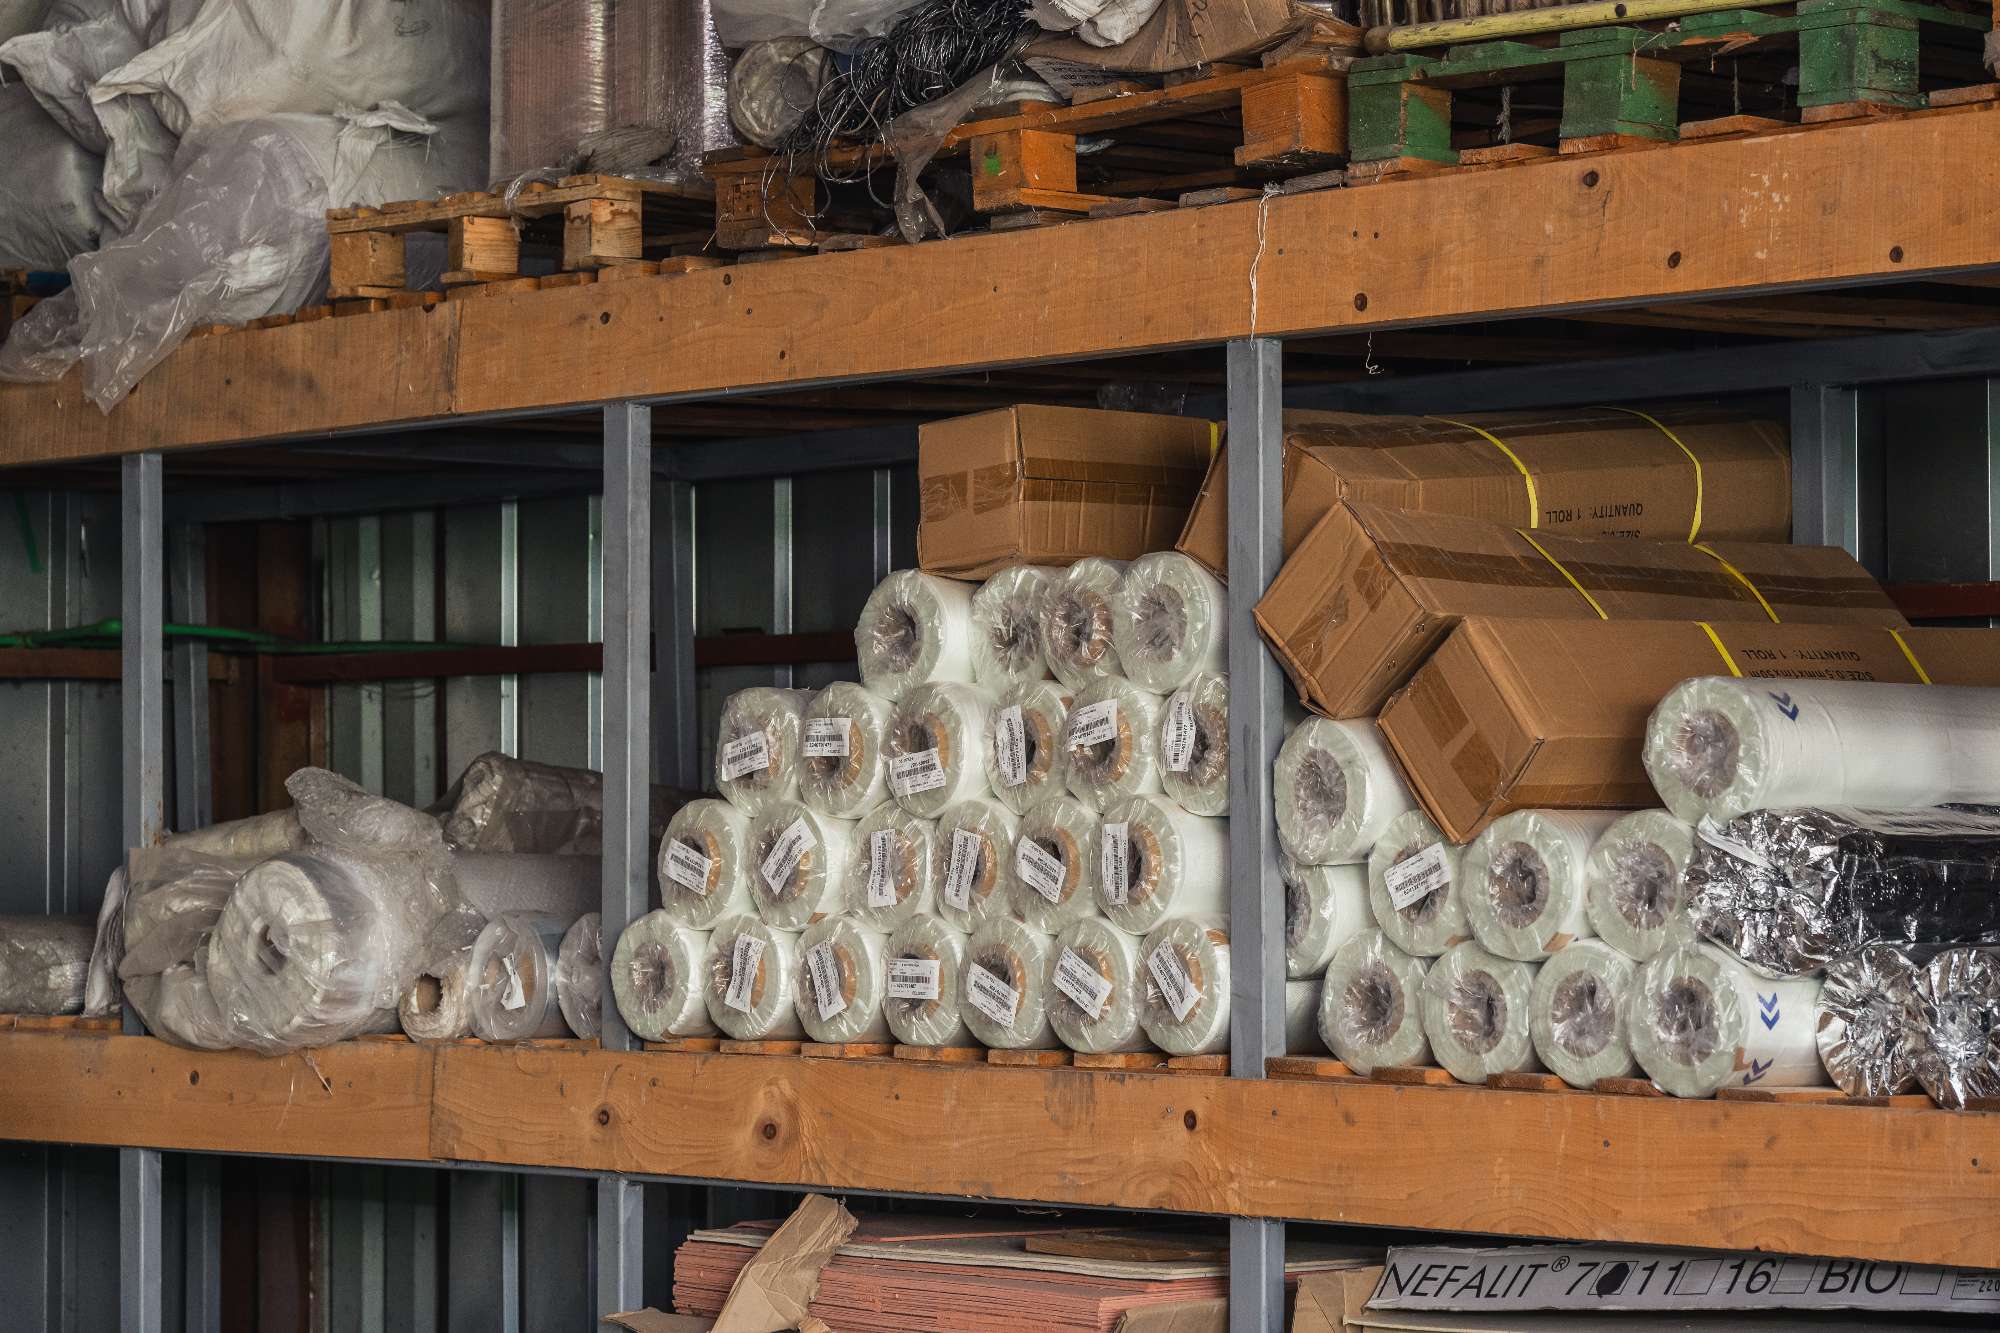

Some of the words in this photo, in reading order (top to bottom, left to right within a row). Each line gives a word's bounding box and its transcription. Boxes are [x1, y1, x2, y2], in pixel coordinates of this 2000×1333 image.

[1545, 509, 1573, 523] ROLL
[1742, 649, 1777, 660] ROLL
[1794, 649, 1861, 661] QUANTITY:
[1564, 1262, 1601, 1296] 7
[1636, 1260, 1686, 1297] 11
[1725, 1257, 1777, 1295] 16
[1816, 1260, 1901, 1294] BIO
